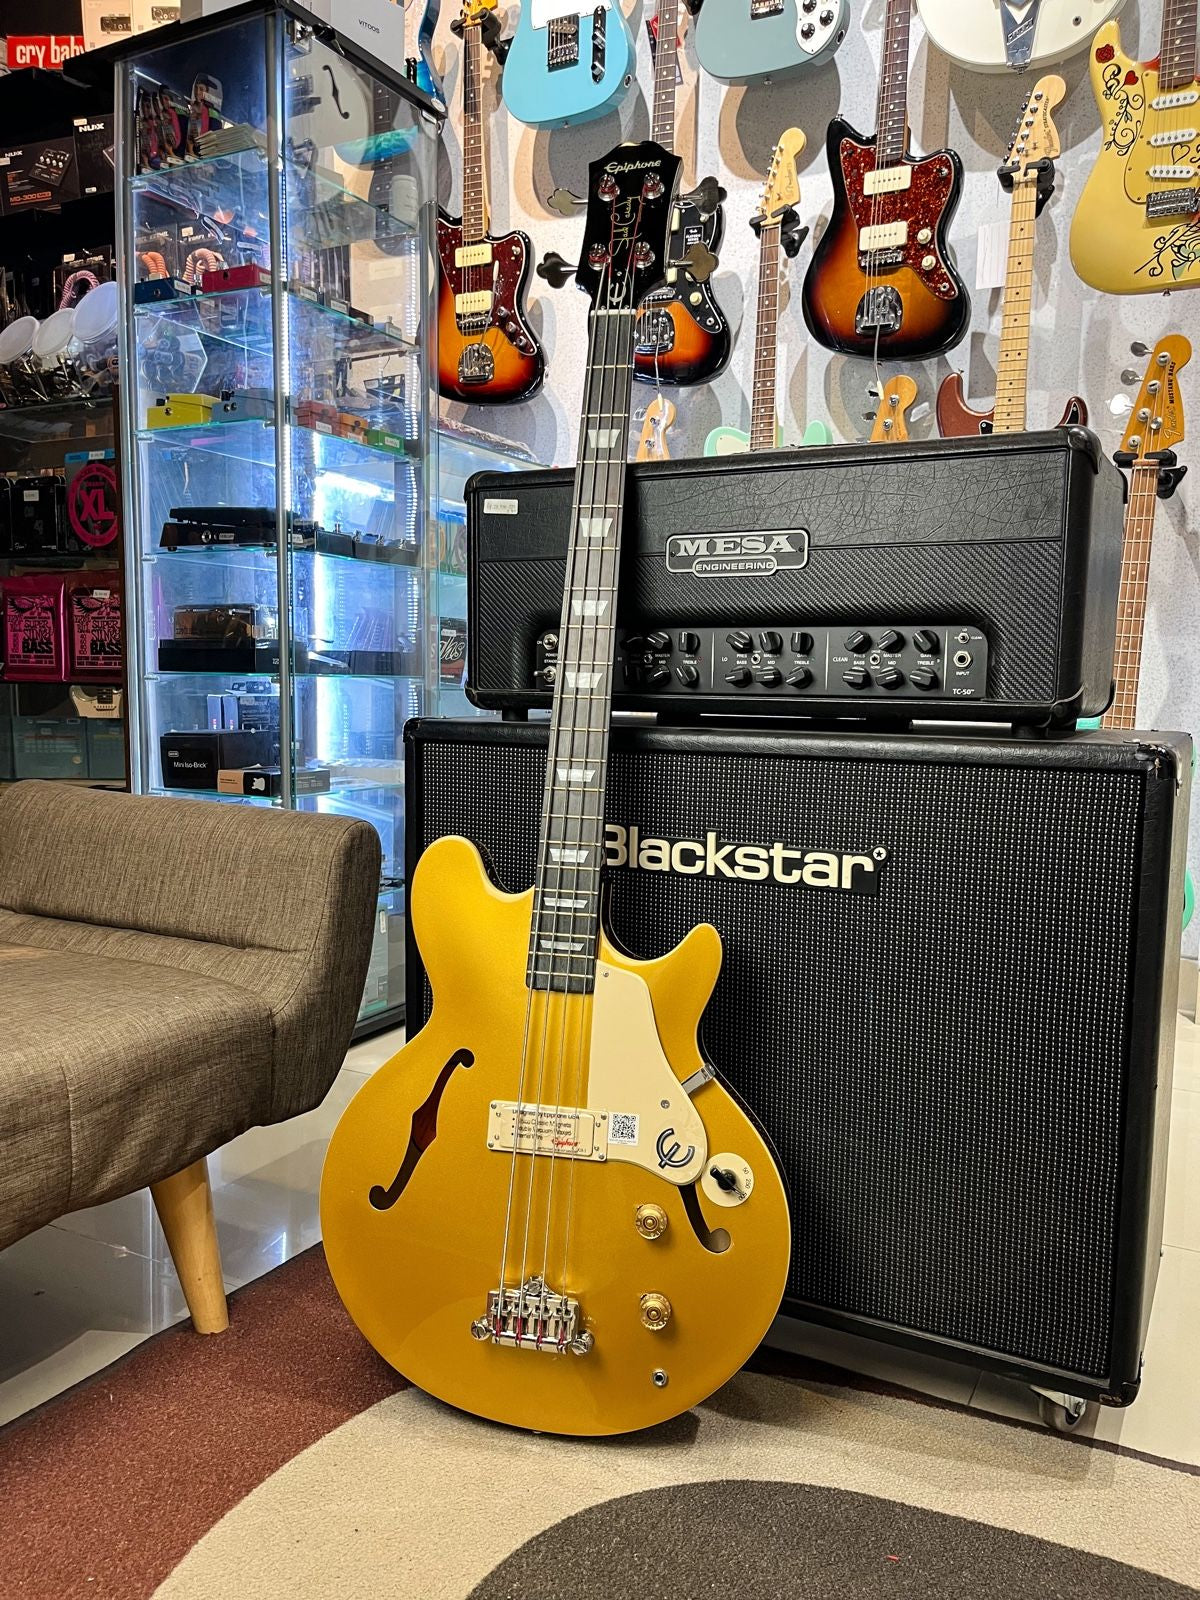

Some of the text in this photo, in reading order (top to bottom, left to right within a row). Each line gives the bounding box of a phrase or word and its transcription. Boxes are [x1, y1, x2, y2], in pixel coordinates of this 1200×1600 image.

[16, 44, 46, 69] cry
[79, 122, 105, 133] NUX
[604, 159, 662, 175] Epiphone
[1167, 379, 1175, 404] MUSTANG
[80, 488, 115, 521] XL
[676, 535, 796, 557] MESA
[695, 561, 774, 571] ENGINEERING
[22, 640, 53, 654] BASS
[604, 824, 874, 890] Blackstar
